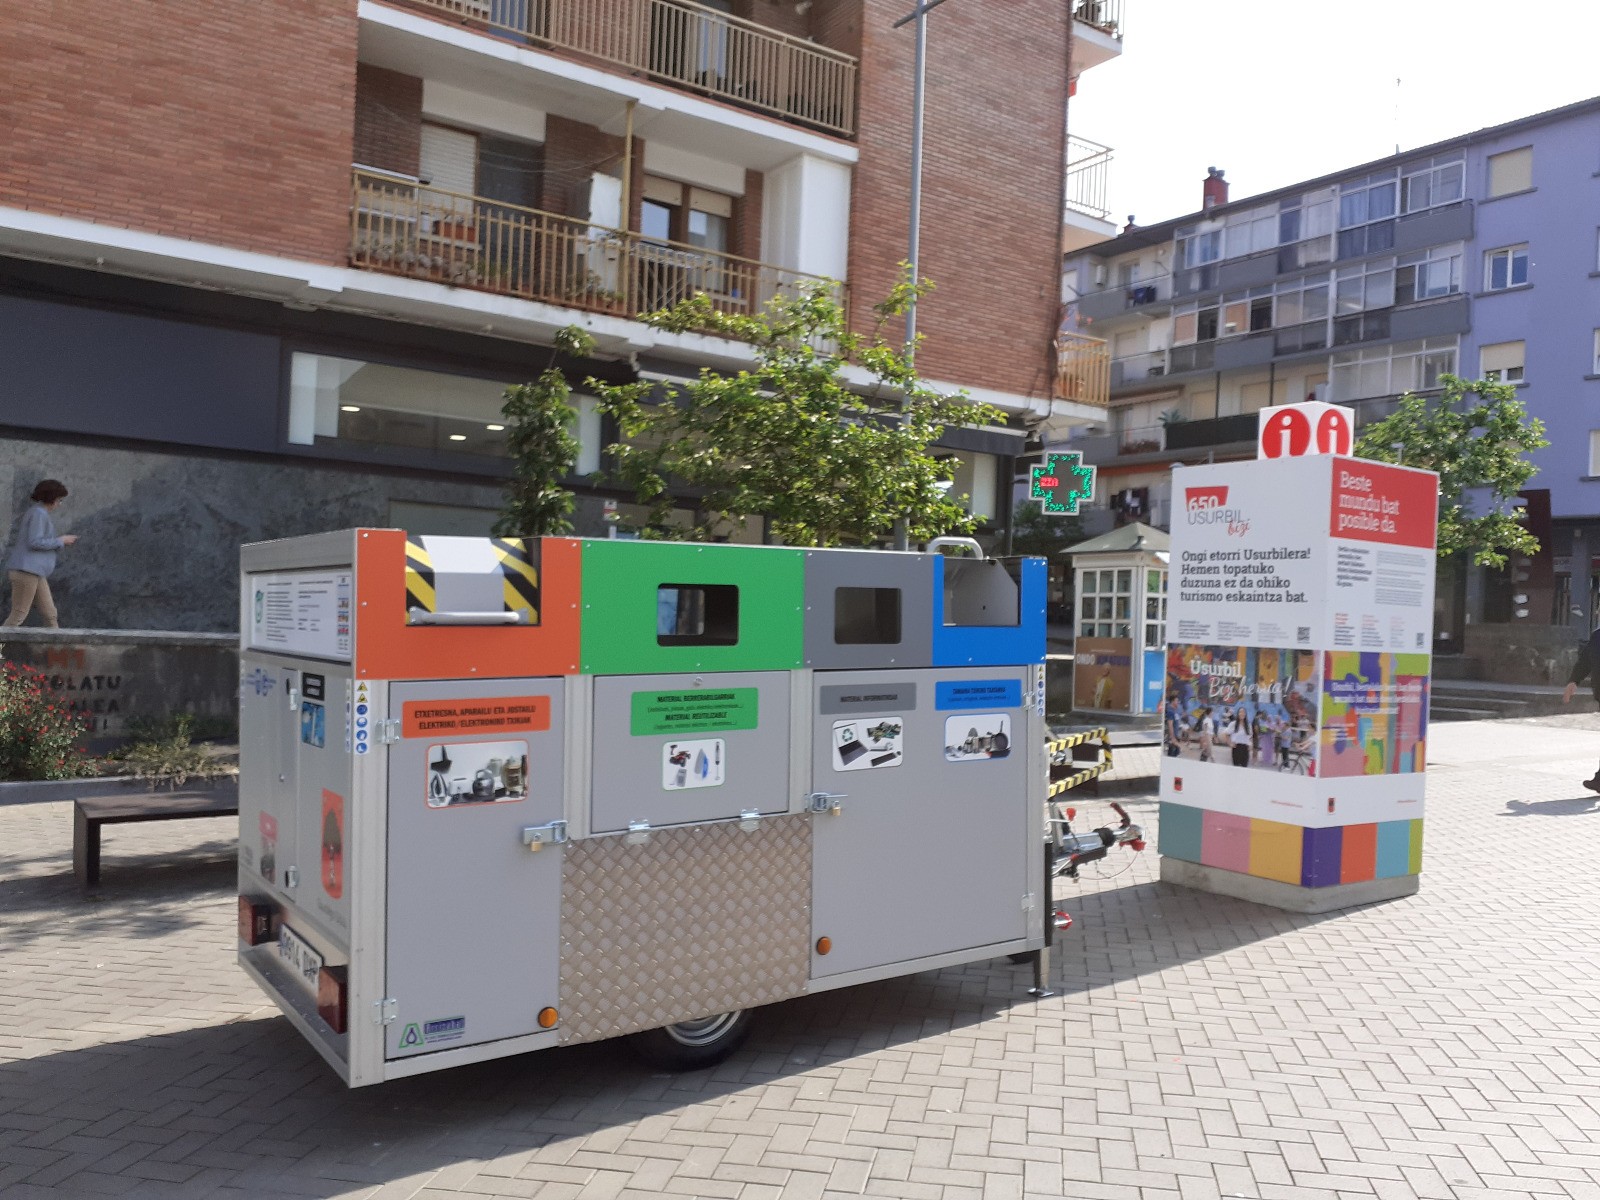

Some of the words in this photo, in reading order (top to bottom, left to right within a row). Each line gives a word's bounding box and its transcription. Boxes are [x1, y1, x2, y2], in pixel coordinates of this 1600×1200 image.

[1340, 471, 1372, 492] Beste
[1187, 495, 1219, 511] 650
[1338, 493, 1381, 513] mundu
[1381, 496, 1400, 515] bat
[1187, 509, 1245, 525] USURBIL
[1338, 512, 1380, 532] posible
[1380, 514, 1398, 533] da.
[1181, 550, 1207, 564] Ongi
[1209, 549, 1241, 561] etorri
[1243, 547, 1311, 560] Usurbilera!
[1181, 564, 1220, 575] Hemen
[1223, 562, 1275, 577] topatuko
[1180, 576, 1221, 588] duzuna
[1224, 579, 1237, 588] ez
[1239, 576, 1254, 588] da
[1256, 576, 1291, 588] ohiko
[1180, 590, 1223, 602] turismo
[1225, 590, 1283, 602] eskaintza
[1285, 590, 1309, 603] bat.
[493, 706, 505, 714] ETA
